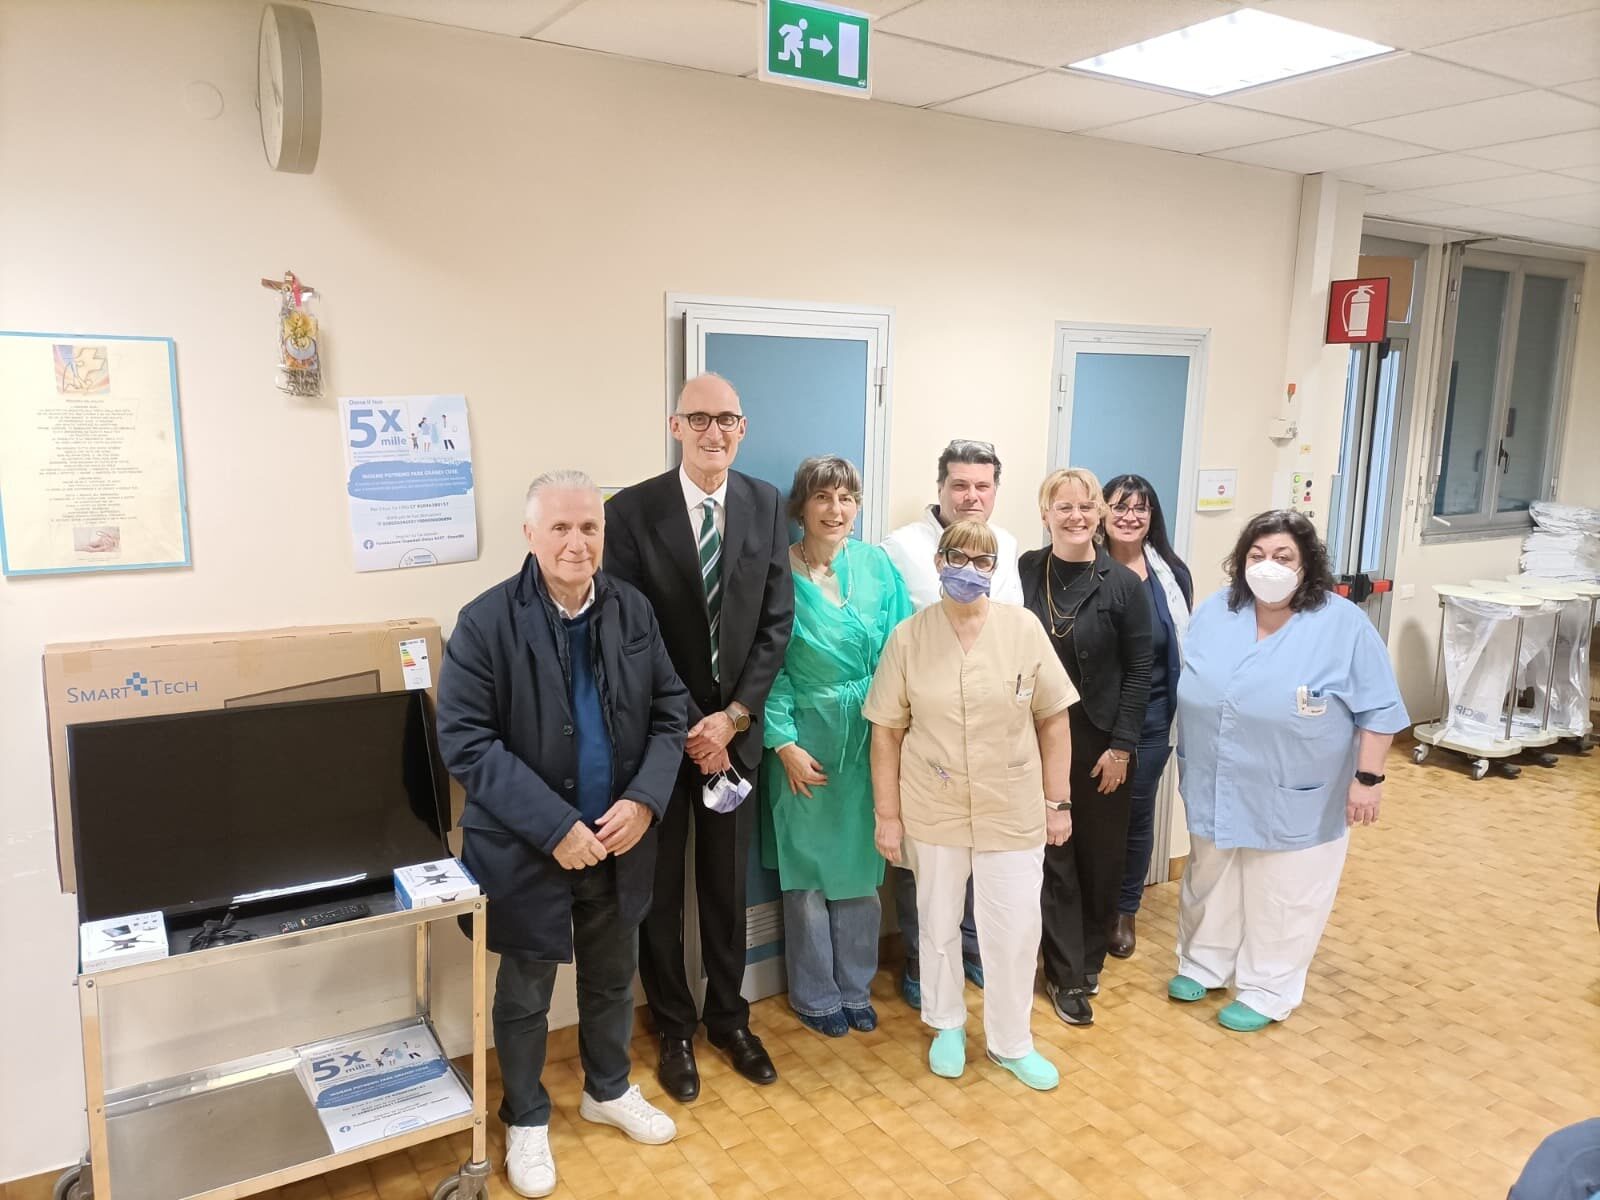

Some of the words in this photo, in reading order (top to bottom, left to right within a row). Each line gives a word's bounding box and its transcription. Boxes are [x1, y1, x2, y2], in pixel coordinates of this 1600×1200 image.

[381, 436, 407, 447] mille
[67, 687, 131, 704] SMART
[150, 679, 199, 695] TECH
